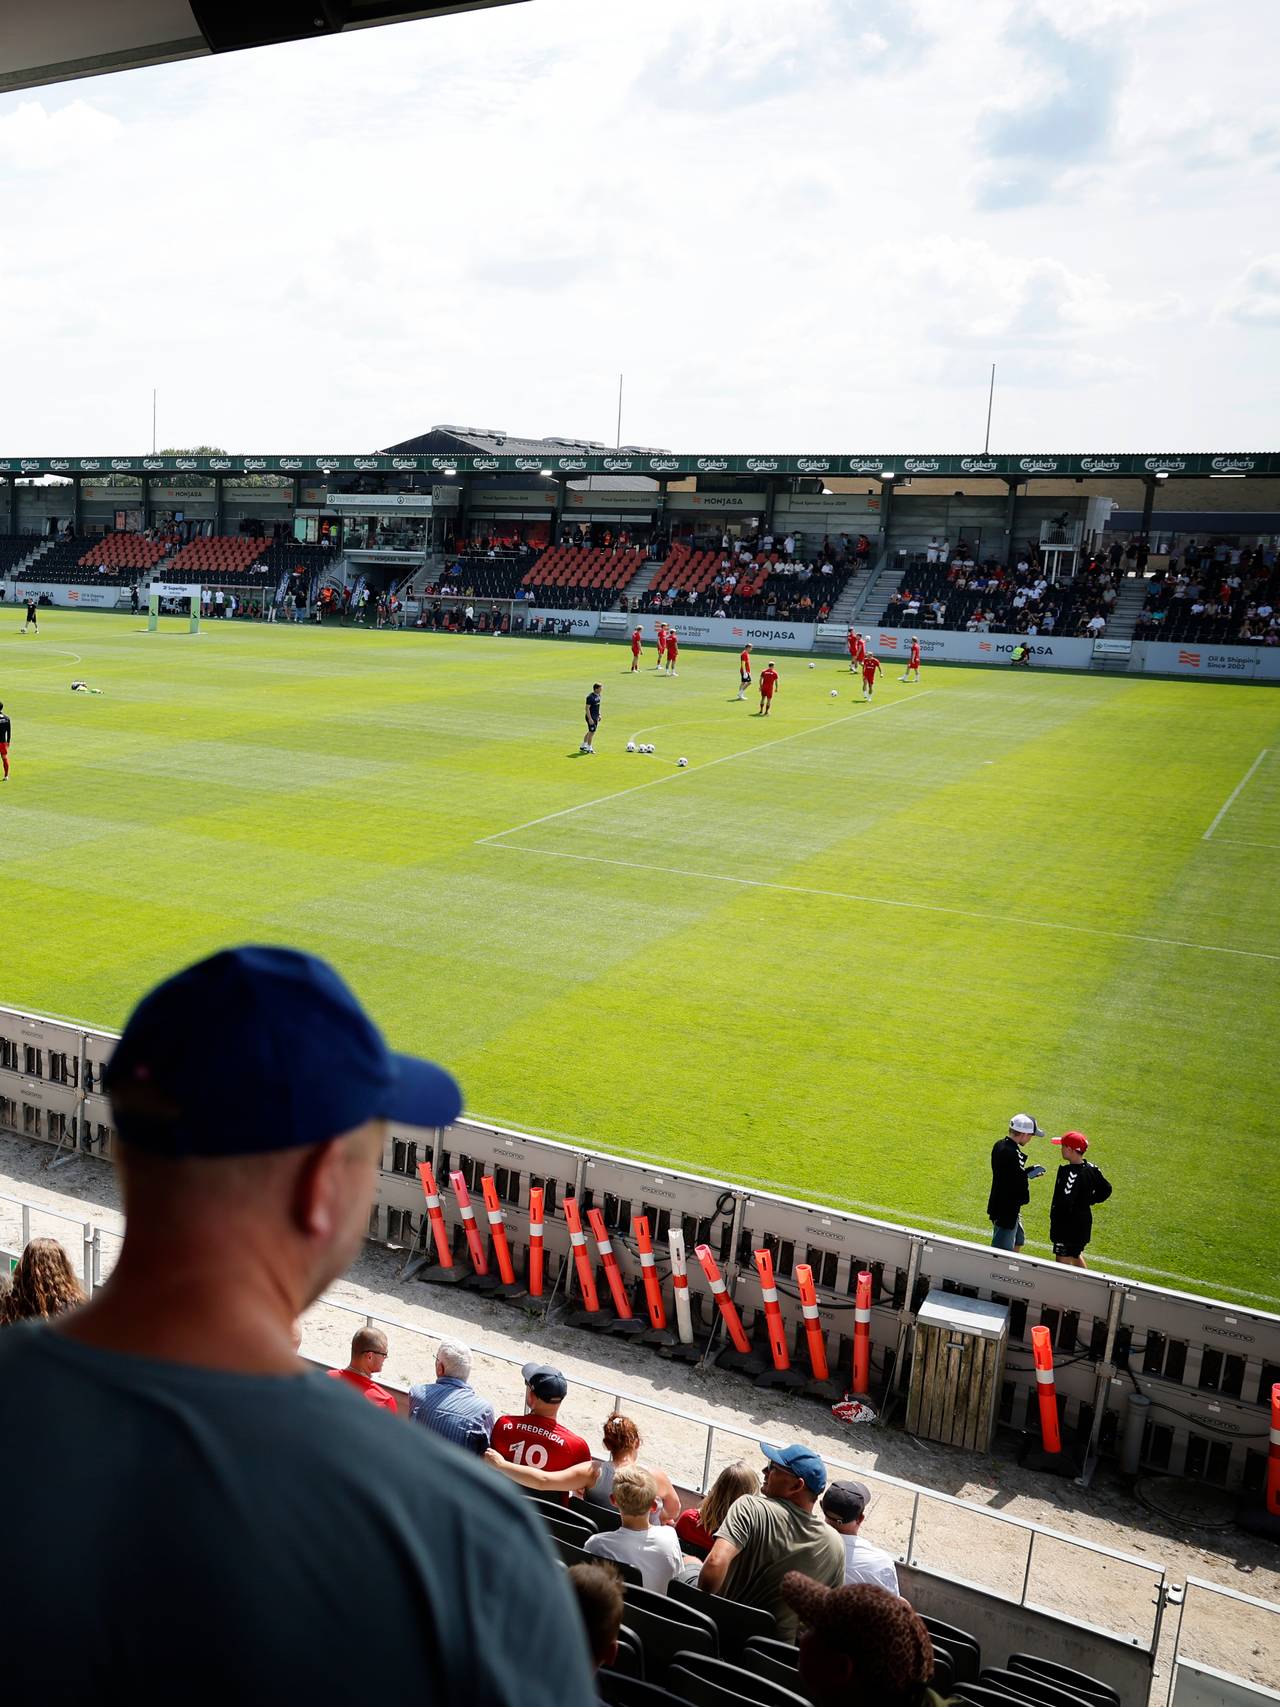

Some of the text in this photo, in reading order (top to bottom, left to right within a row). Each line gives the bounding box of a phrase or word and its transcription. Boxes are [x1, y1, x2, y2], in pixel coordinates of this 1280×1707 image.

[392, 458, 417, 470] Carlsberg
[432, 458, 458, 470] Carlsberg
[472, 458, 499, 470] Carlsberg
[515, 458, 543, 470] Carlsberg
[558, 458, 587, 470] Carlsberg
[603, 458, 633, 470] Carlsberg
[649, 458, 679, 470] Carlsberg
[697, 458, 728, 471] Carlsberg
[746, 458, 779, 471] Carlsberg
[796, 458, 830, 471] Carlsberg
[849, 458, 884, 471] Carlsberg
[904, 458, 940, 471] Carlsberg
[960, 458, 998, 472] Carlsberg
[1019, 458, 1057, 472] Carlsberg
[1080, 458, 1121, 473] Carlsberg
[1144, 458, 1186, 473] Carlsberg
[1211, 458, 1256, 473] Carlsberg
[704, 498, 743, 506] MONJASA
[747, 630, 795, 640] MONJASA
[920, 640, 945, 648] Shipping
[996, 644, 1053, 655] MOASA
[1227, 657, 1261, 665] Shipping
[641, 1185, 675, 1198] expromo
[807, 1227, 845, 1241] expromo
[991, 1273, 1034, 1287] expromo
[1204, 1325, 1253, 1342] expromo
[516, 1423, 565, 1446] FREDERICIA
[509, 1440, 548, 1469] 10
